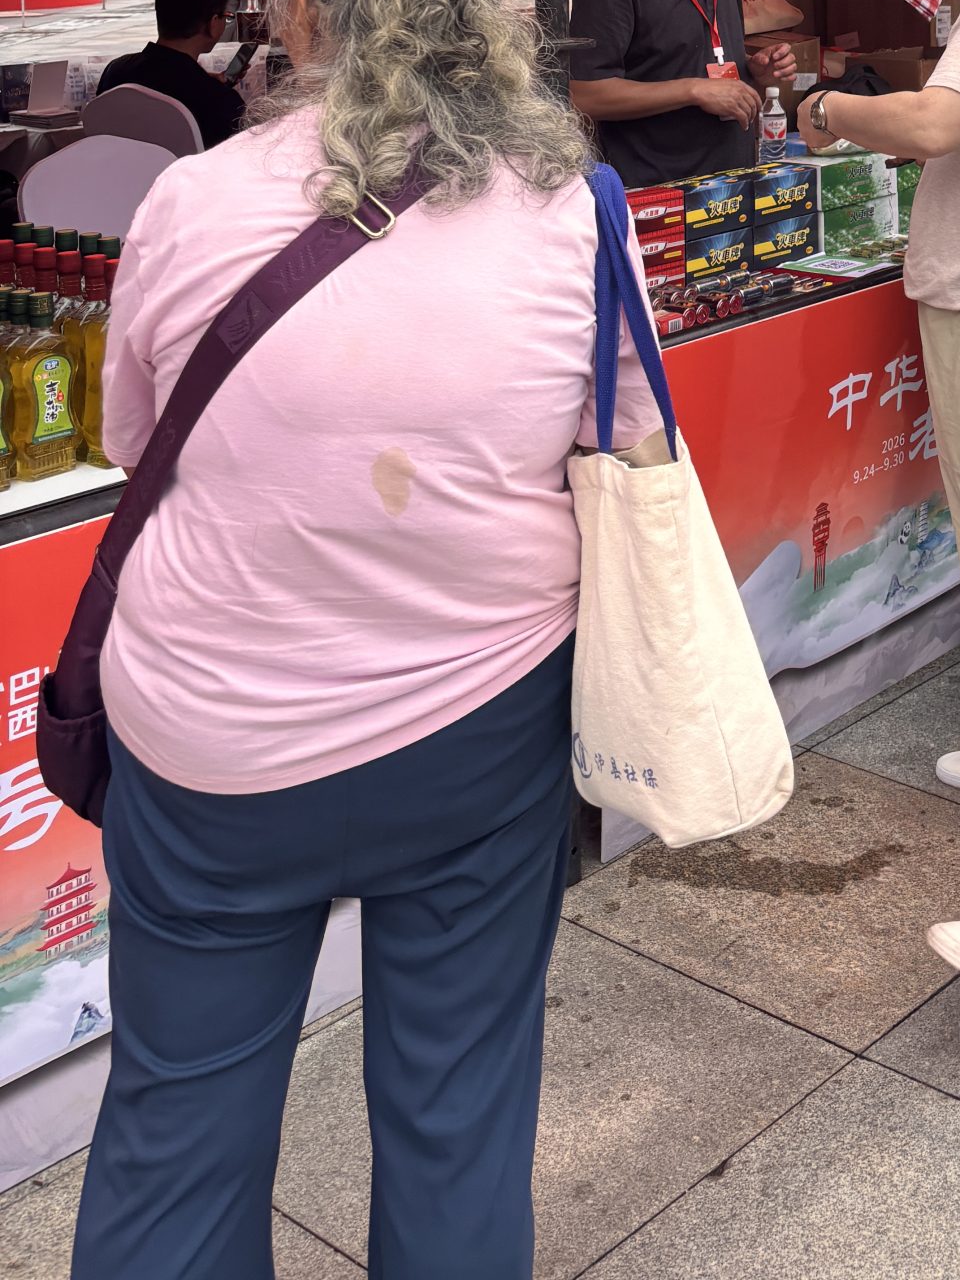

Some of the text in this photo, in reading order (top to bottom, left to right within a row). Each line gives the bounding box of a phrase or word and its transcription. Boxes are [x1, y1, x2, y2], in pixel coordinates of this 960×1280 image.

[710, 196, 742, 218] 火車牌
[710, 243, 743, 267] 火車牌
[827, 354, 923, 431] 中华
[882, 432, 905, 454] 2026
[9, 666, 50, 706] 巴
